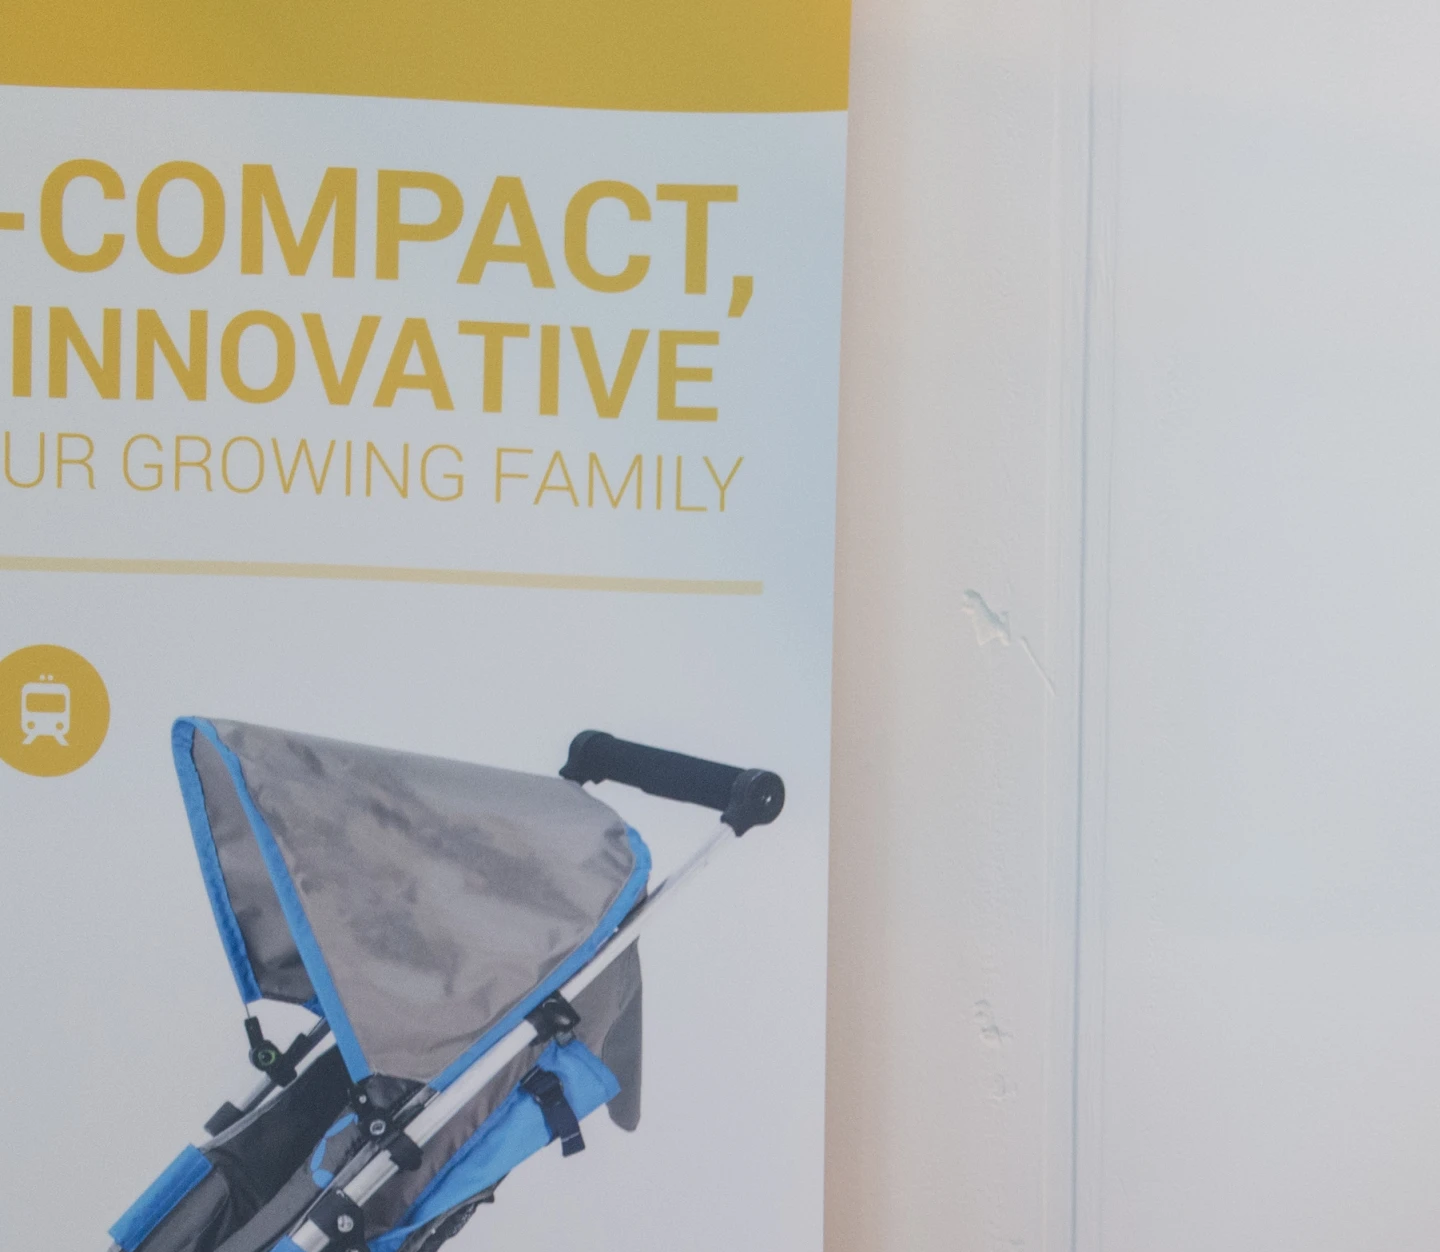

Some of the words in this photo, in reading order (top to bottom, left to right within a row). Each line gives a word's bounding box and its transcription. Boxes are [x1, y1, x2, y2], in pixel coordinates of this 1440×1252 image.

[12, 304, 720, 423] INNOVATIVE
[4, 430, 96, 490] UR
[122, 433, 464, 502] GROWING
[494, 447, 744, 512] FAMILY
